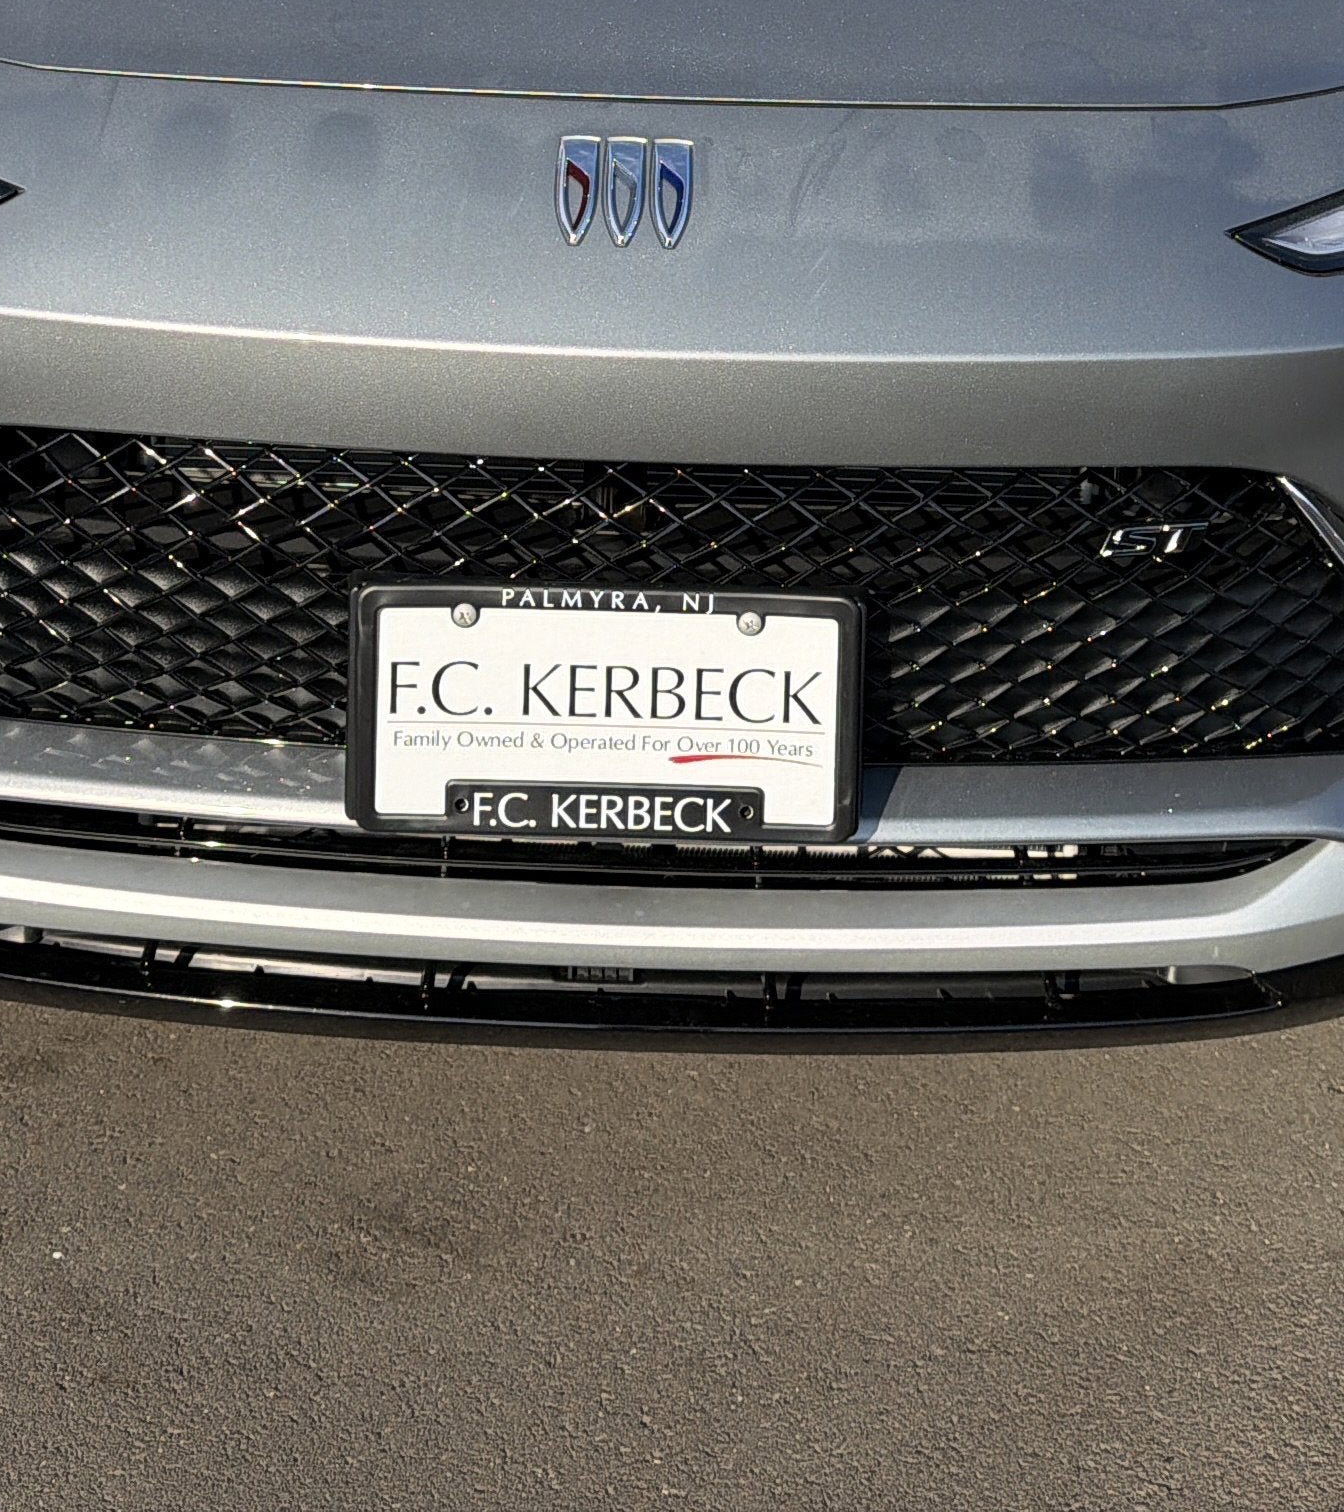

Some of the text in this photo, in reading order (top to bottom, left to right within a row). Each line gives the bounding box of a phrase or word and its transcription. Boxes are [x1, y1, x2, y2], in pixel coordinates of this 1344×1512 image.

[1099, 522, 1209, 557] ST
[501, 588, 715, 615] PALMYRA, NJ
[388, 660, 823, 726] F.C. KERBECK
[393, 730, 814, 758] Family Owned & Operated For Over 100 Years
[473, 791, 732, 833] F.C. KERBECK
